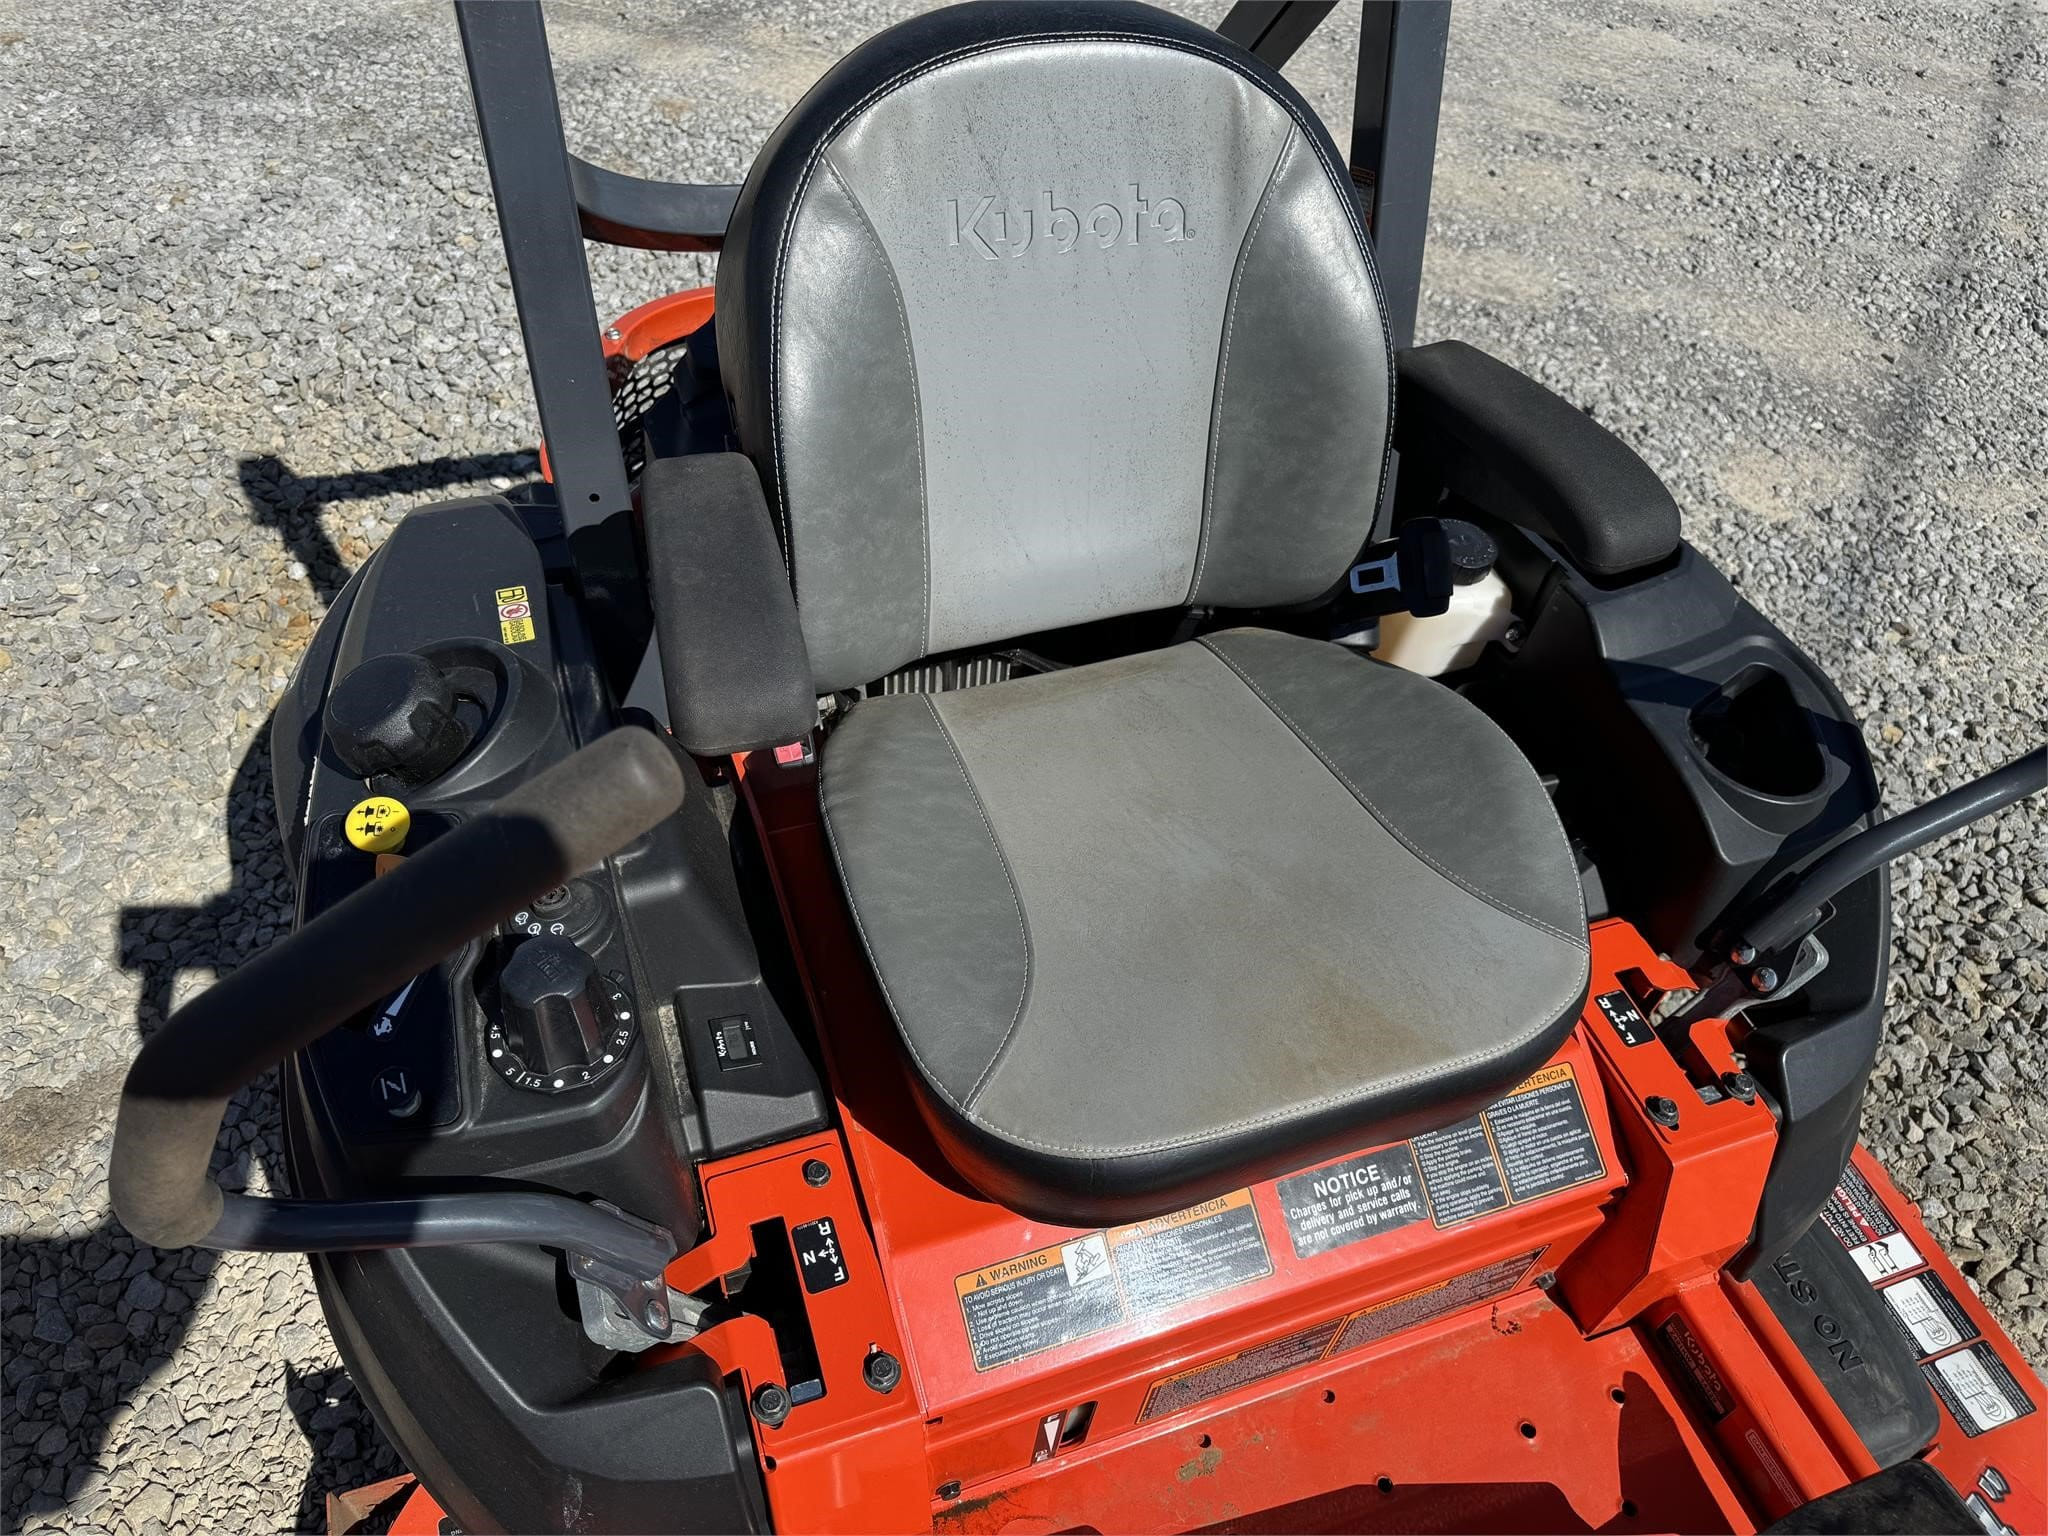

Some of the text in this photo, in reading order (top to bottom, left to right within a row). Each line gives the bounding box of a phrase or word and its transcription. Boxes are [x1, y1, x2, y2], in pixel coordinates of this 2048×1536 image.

[1598, 998, 1612, 1009] R
[1626, 1009, 1640, 1021] N
[615, 1031, 629, 1046] 2.5
[1626, 1032, 1636, 1044] F
[505, 1067, 515, 1076] 5
[582, 1071, 590, 1079] 2
[524, 1077, 542, 1088] 1.5
[1313, 1164, 1379, 1197] NOTICE
[1290, 1202, 1326, 1219] Charges
[1345, 1188, 1364, 1205] pick
[1380, 1175, 1411, 1191] and/or
[1148, 1198, 1228, 1230] ADVERTENCIA
[1300, 1188, 1410, 1230] delivery and service calls
[1183, 1214, 1222, 1232] PERSONALES
[1330, 1216, 1364, 1235] covered
[1365, 1213, 1377, 1224] by
[1379, 1201, 1420, 1219] warranty.
[1835, 1213, 1848, 1227] INTO
[818, 1221, 831, 1236] R
[1847, 1219, 1866, 1241] ENGINE
[1845, 1229, 1859, 1244] FEET
[802, 1250, 816, 1265] N
[834, 1266, 845, 1282] F
[989, 1254, 1046, 1280] WARNING
[1807, 1309, 1865, 1375] NO
